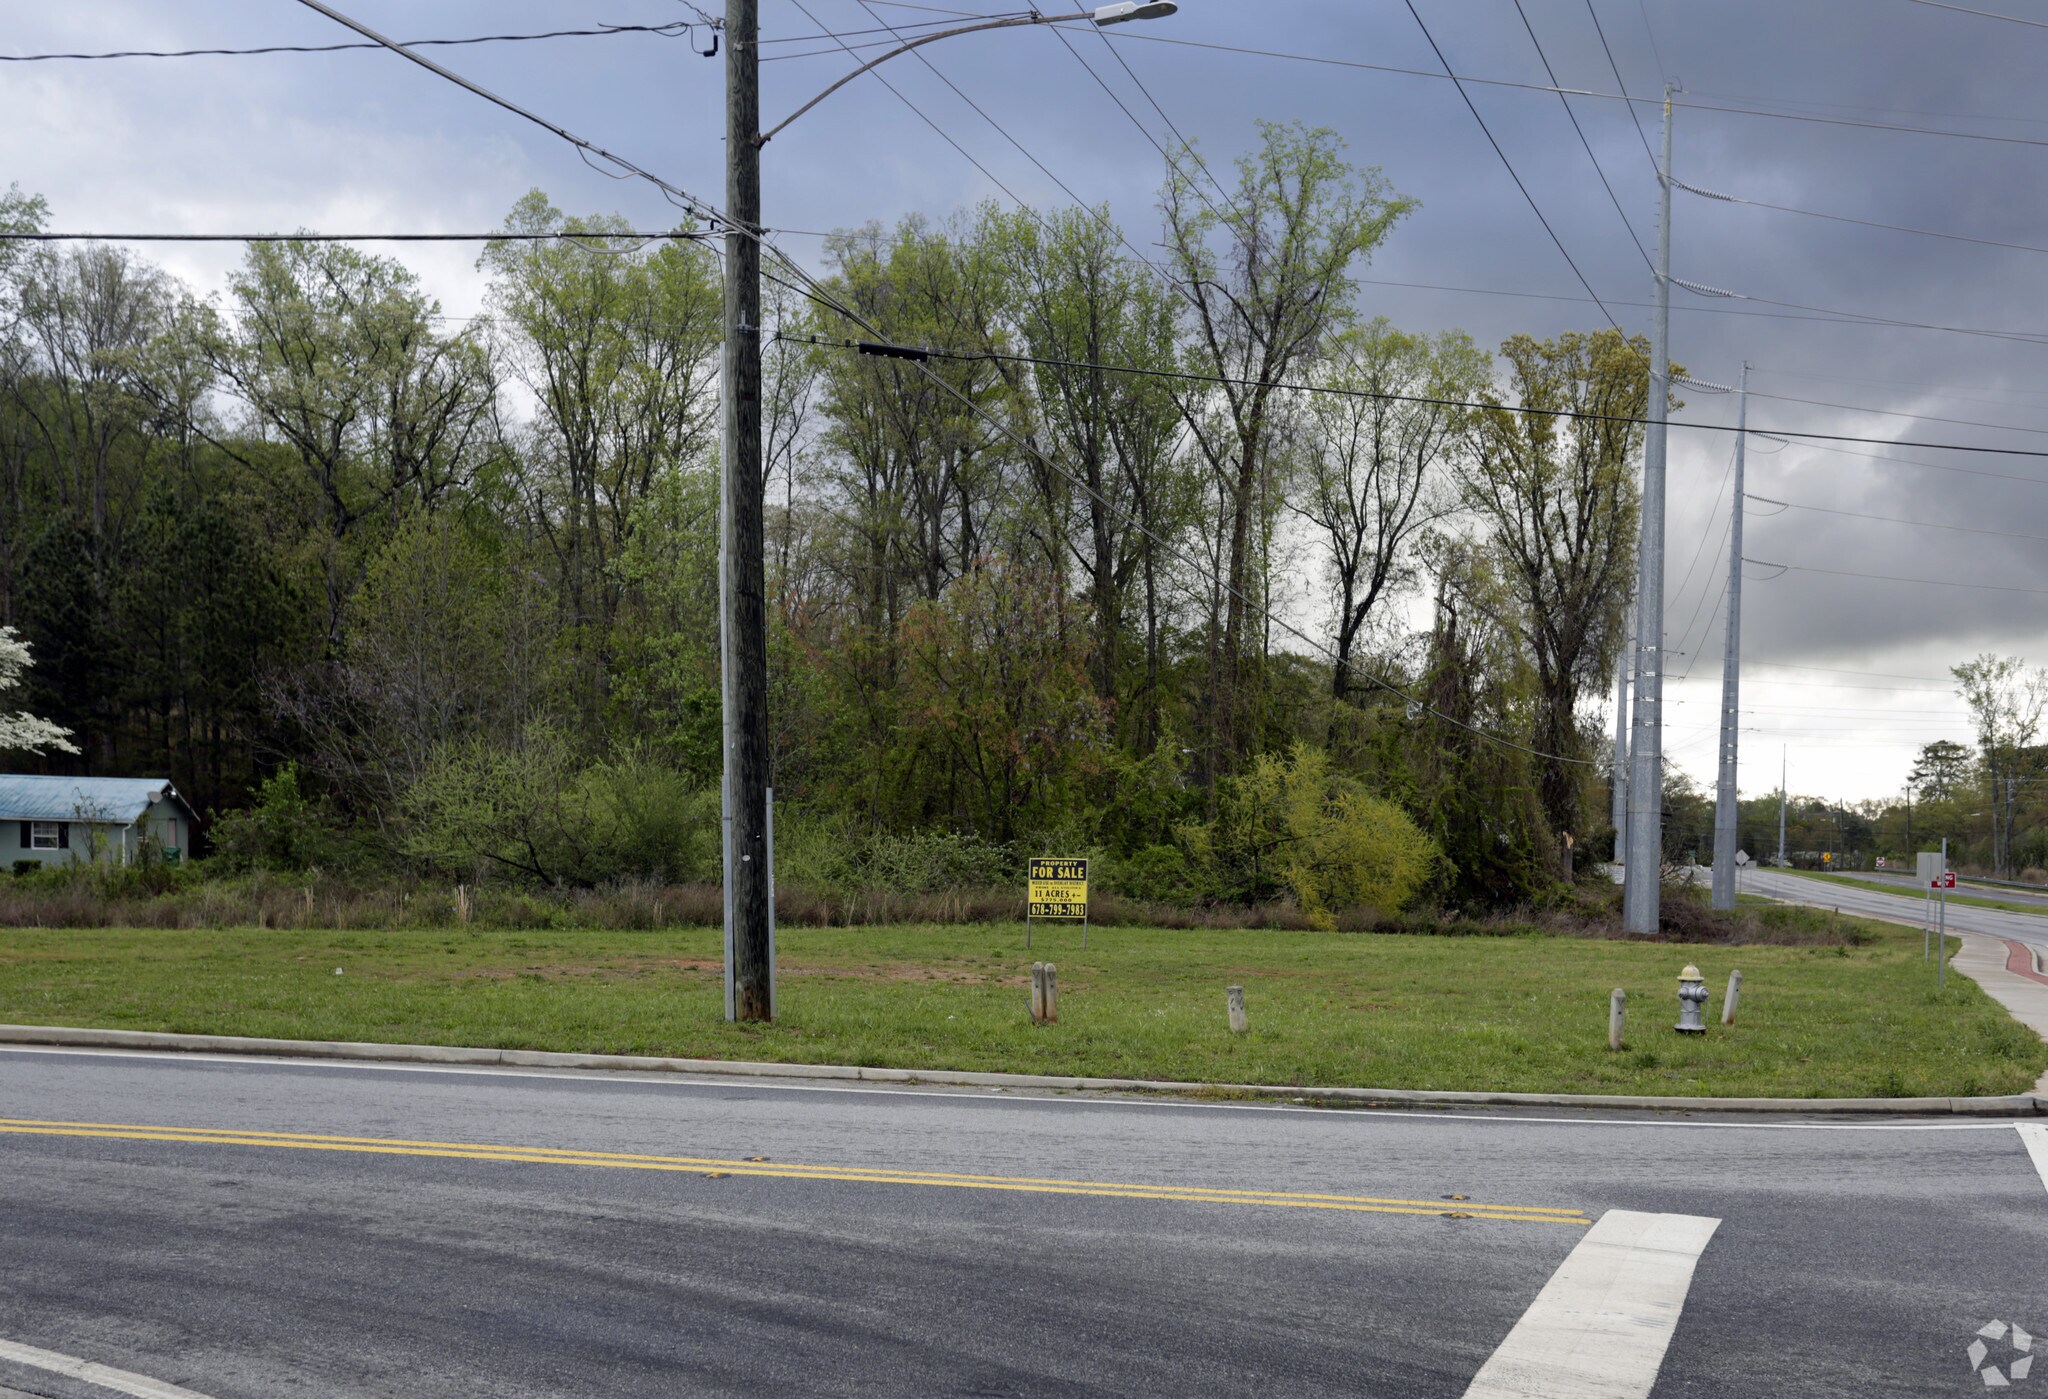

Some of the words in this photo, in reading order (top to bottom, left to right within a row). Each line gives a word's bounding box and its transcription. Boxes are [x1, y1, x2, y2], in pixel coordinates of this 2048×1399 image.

[1032, 866, 1053, 878] FOR
[1057, 867, 1084, 878] SALE
[1046, 890, 1070, 898] ACRES
[1032, 904, 1084, 916] 678-799-7983
